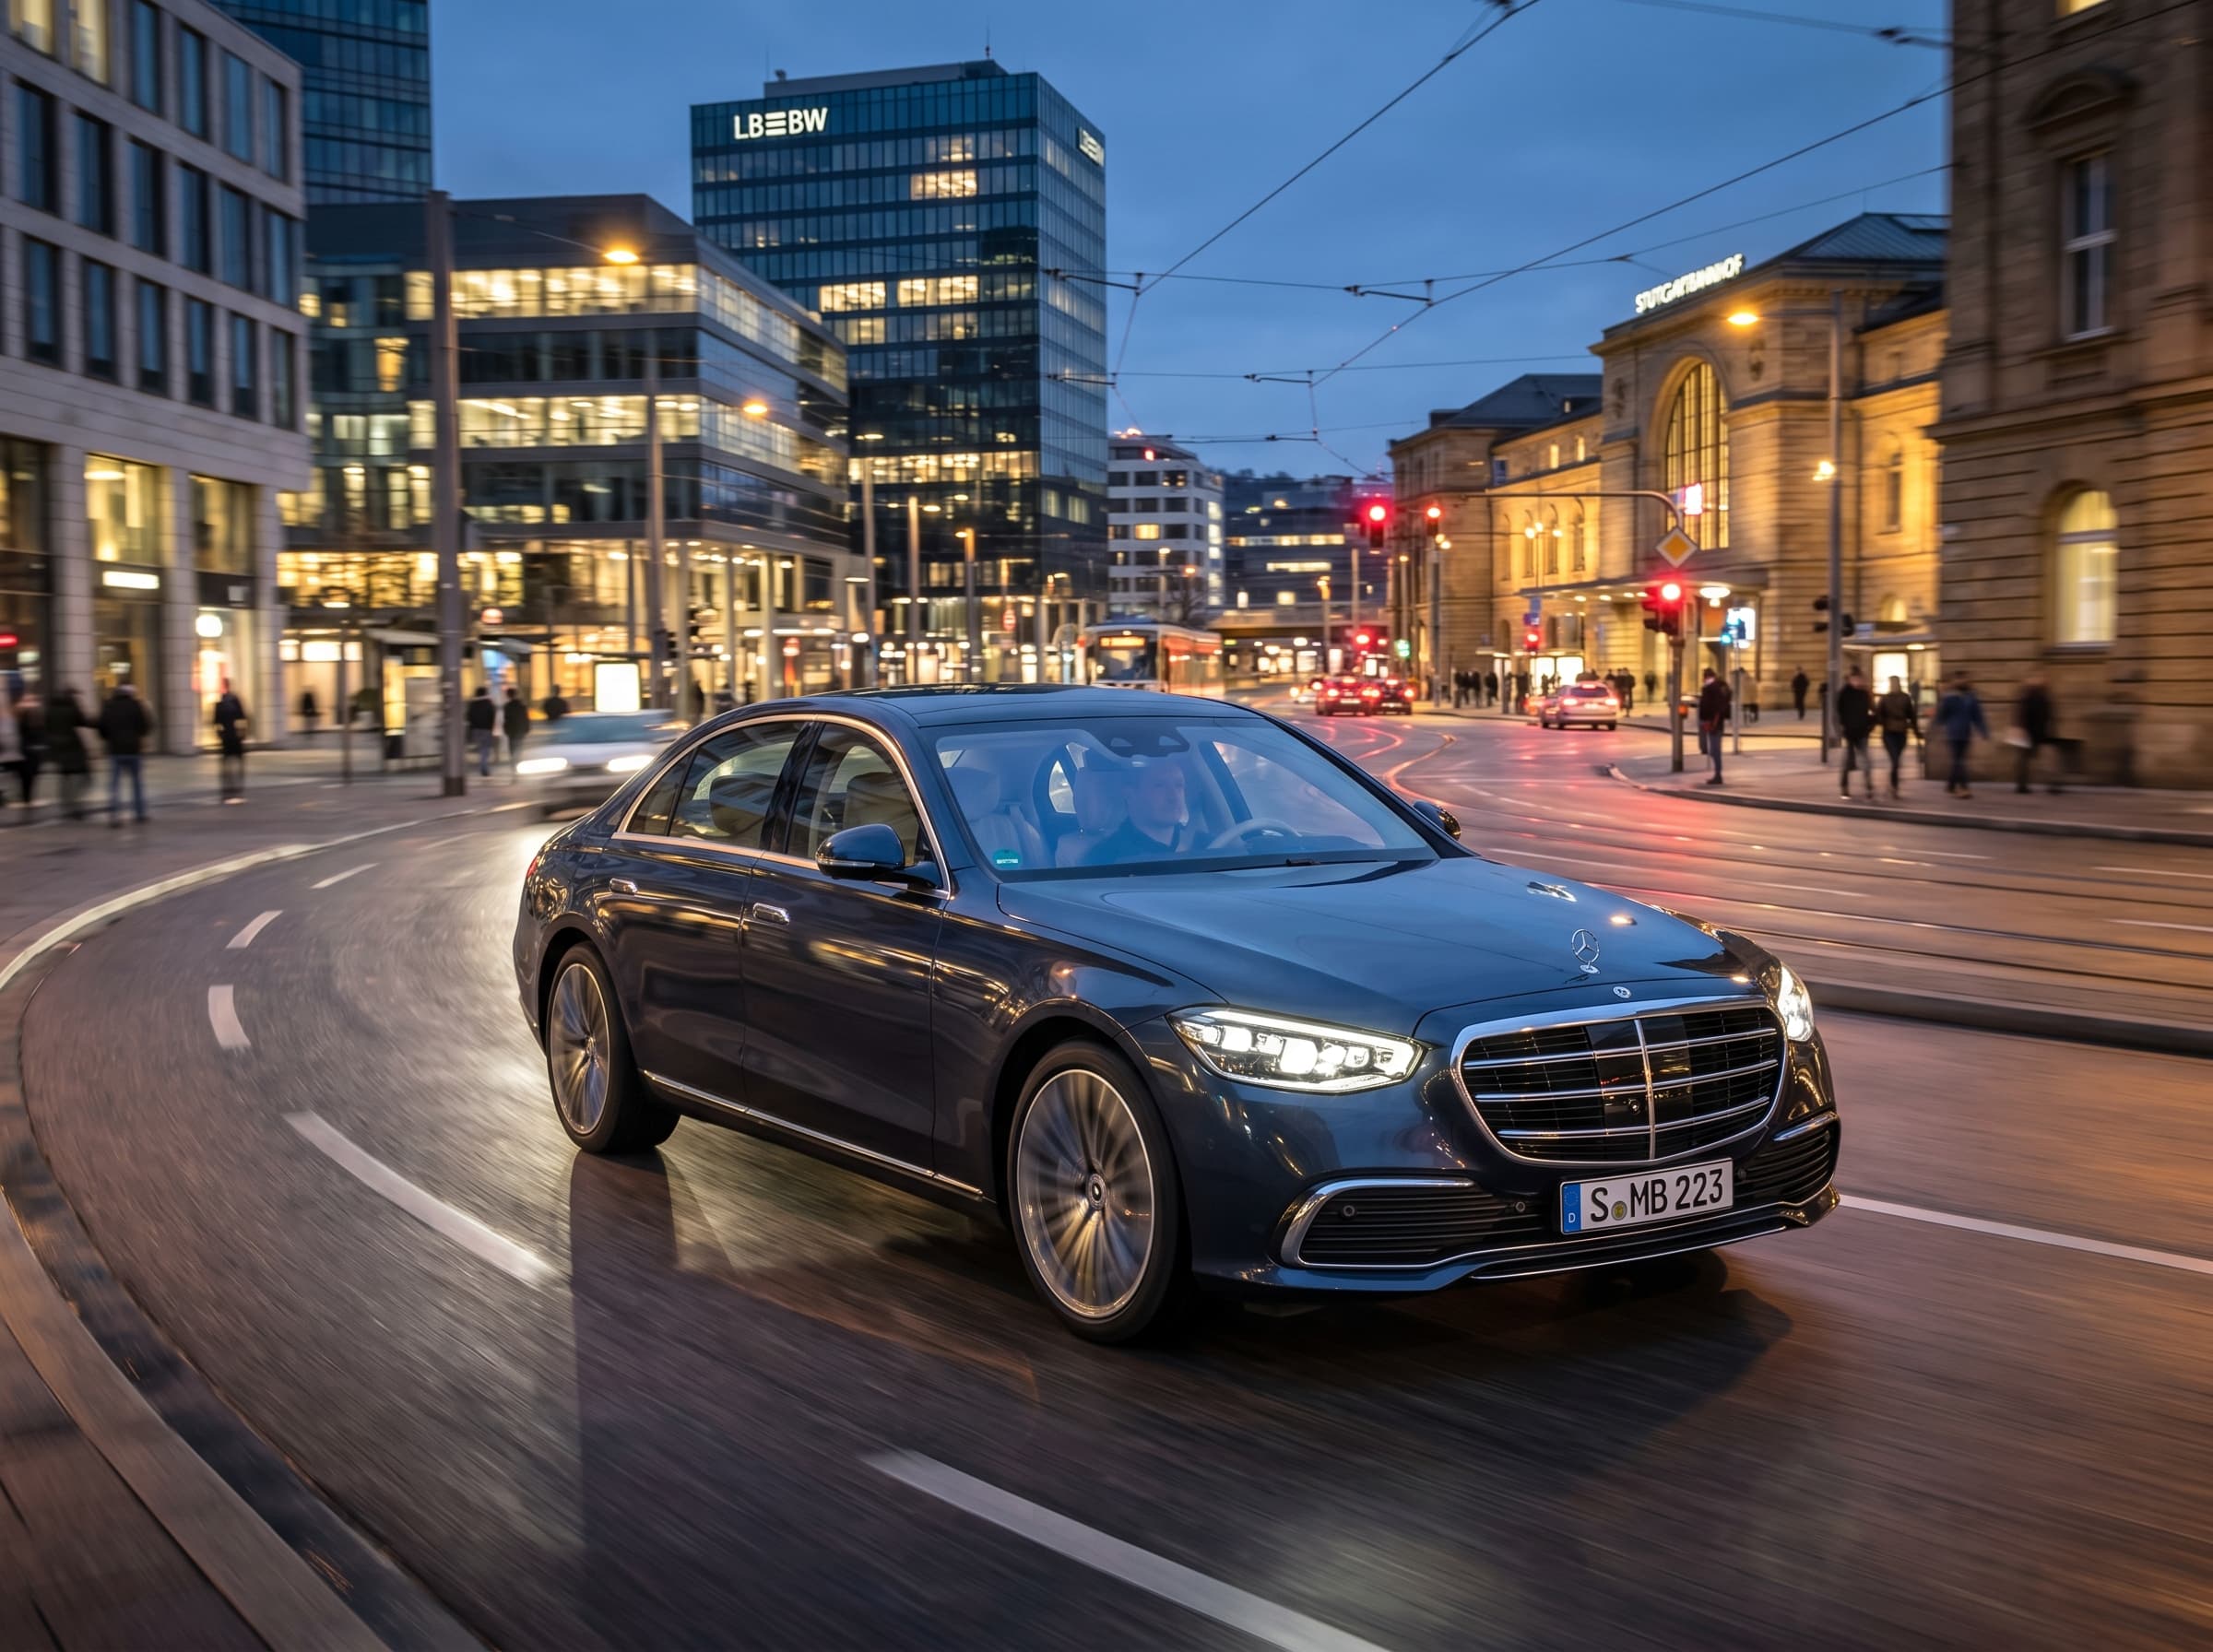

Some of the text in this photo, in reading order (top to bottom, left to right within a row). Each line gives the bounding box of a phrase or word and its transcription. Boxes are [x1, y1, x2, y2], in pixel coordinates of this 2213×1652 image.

[1591, 1168, 1724, 1222] S MB 223
[1568, 1212, 1576, 1223] D
